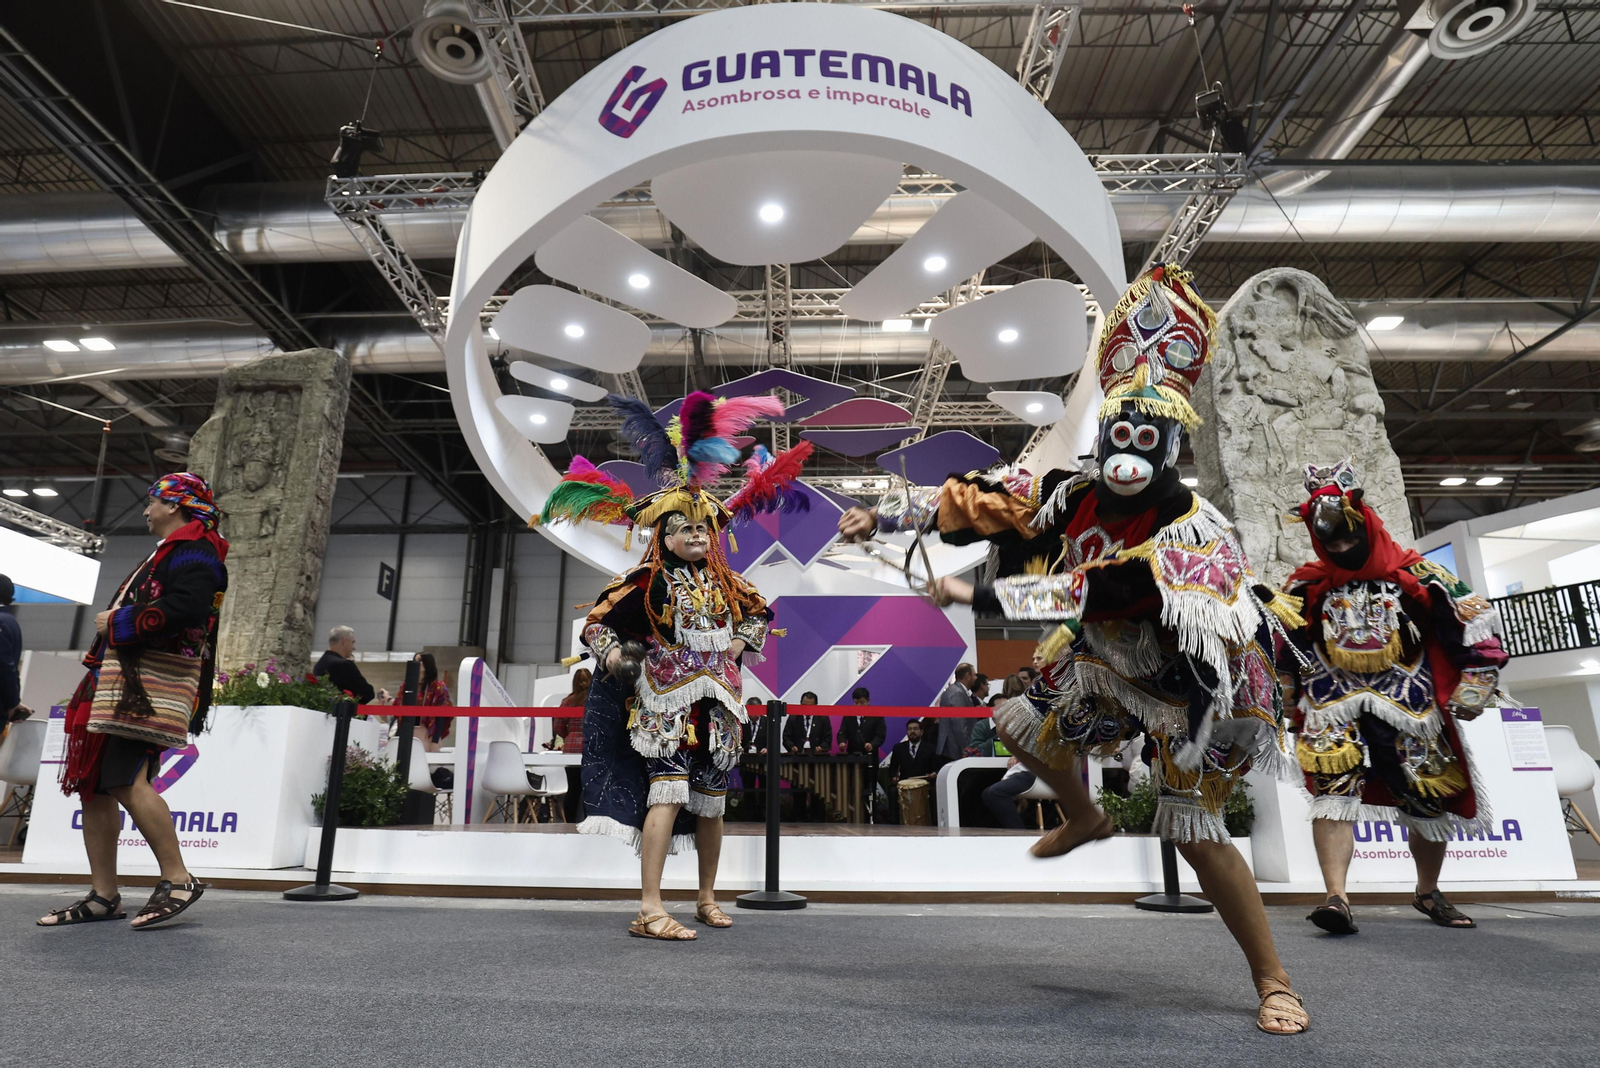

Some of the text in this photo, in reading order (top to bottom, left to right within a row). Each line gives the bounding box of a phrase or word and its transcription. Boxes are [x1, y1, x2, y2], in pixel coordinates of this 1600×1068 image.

[682, 49, 973, 118] GUATEMALA
[681, 86, 931, 119] Asombrosa e imparable
[382, 569, 391, 592] F
[71, 809, 238, 833] GMALA
[1352, 819, 1523, 842] UATLA
[1353, 847, 1508, 861] Asombro mparable
